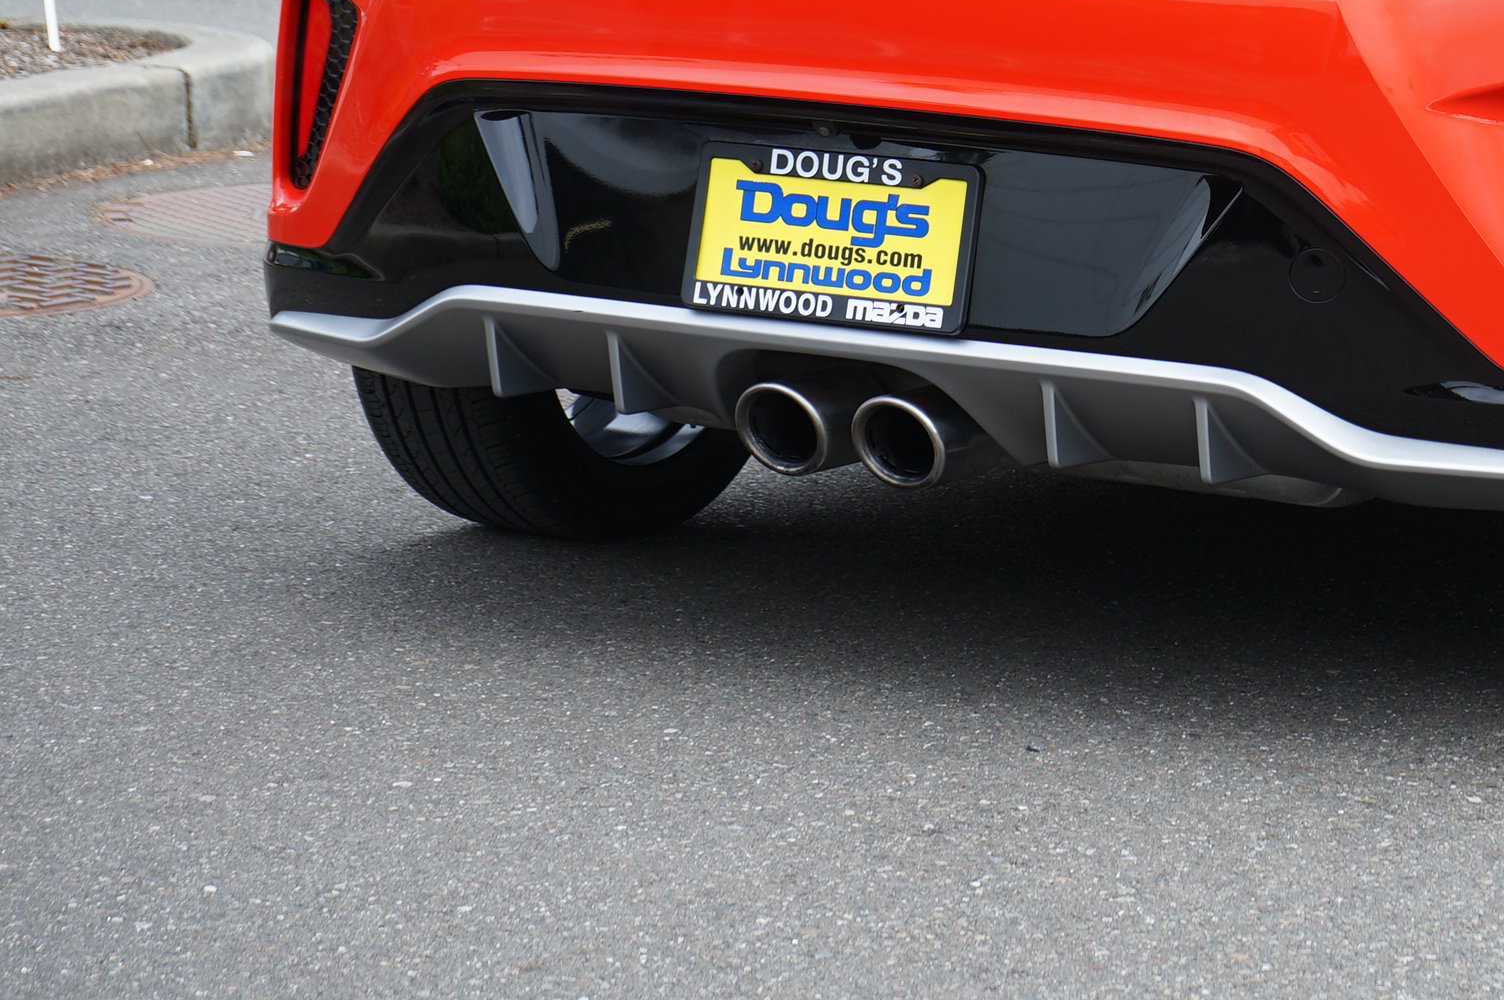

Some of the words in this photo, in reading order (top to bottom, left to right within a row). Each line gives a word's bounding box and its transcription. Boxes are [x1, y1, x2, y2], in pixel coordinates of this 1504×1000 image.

[769, 148, 903, 186] DOUG'S
[736, 179, 931, 248] Doug's
[738, 235, 923, 269] www.dougs.com
[720, 248, 932, 297] Lynnwood
[693, 281, 833, 318] LYNNWOOD
